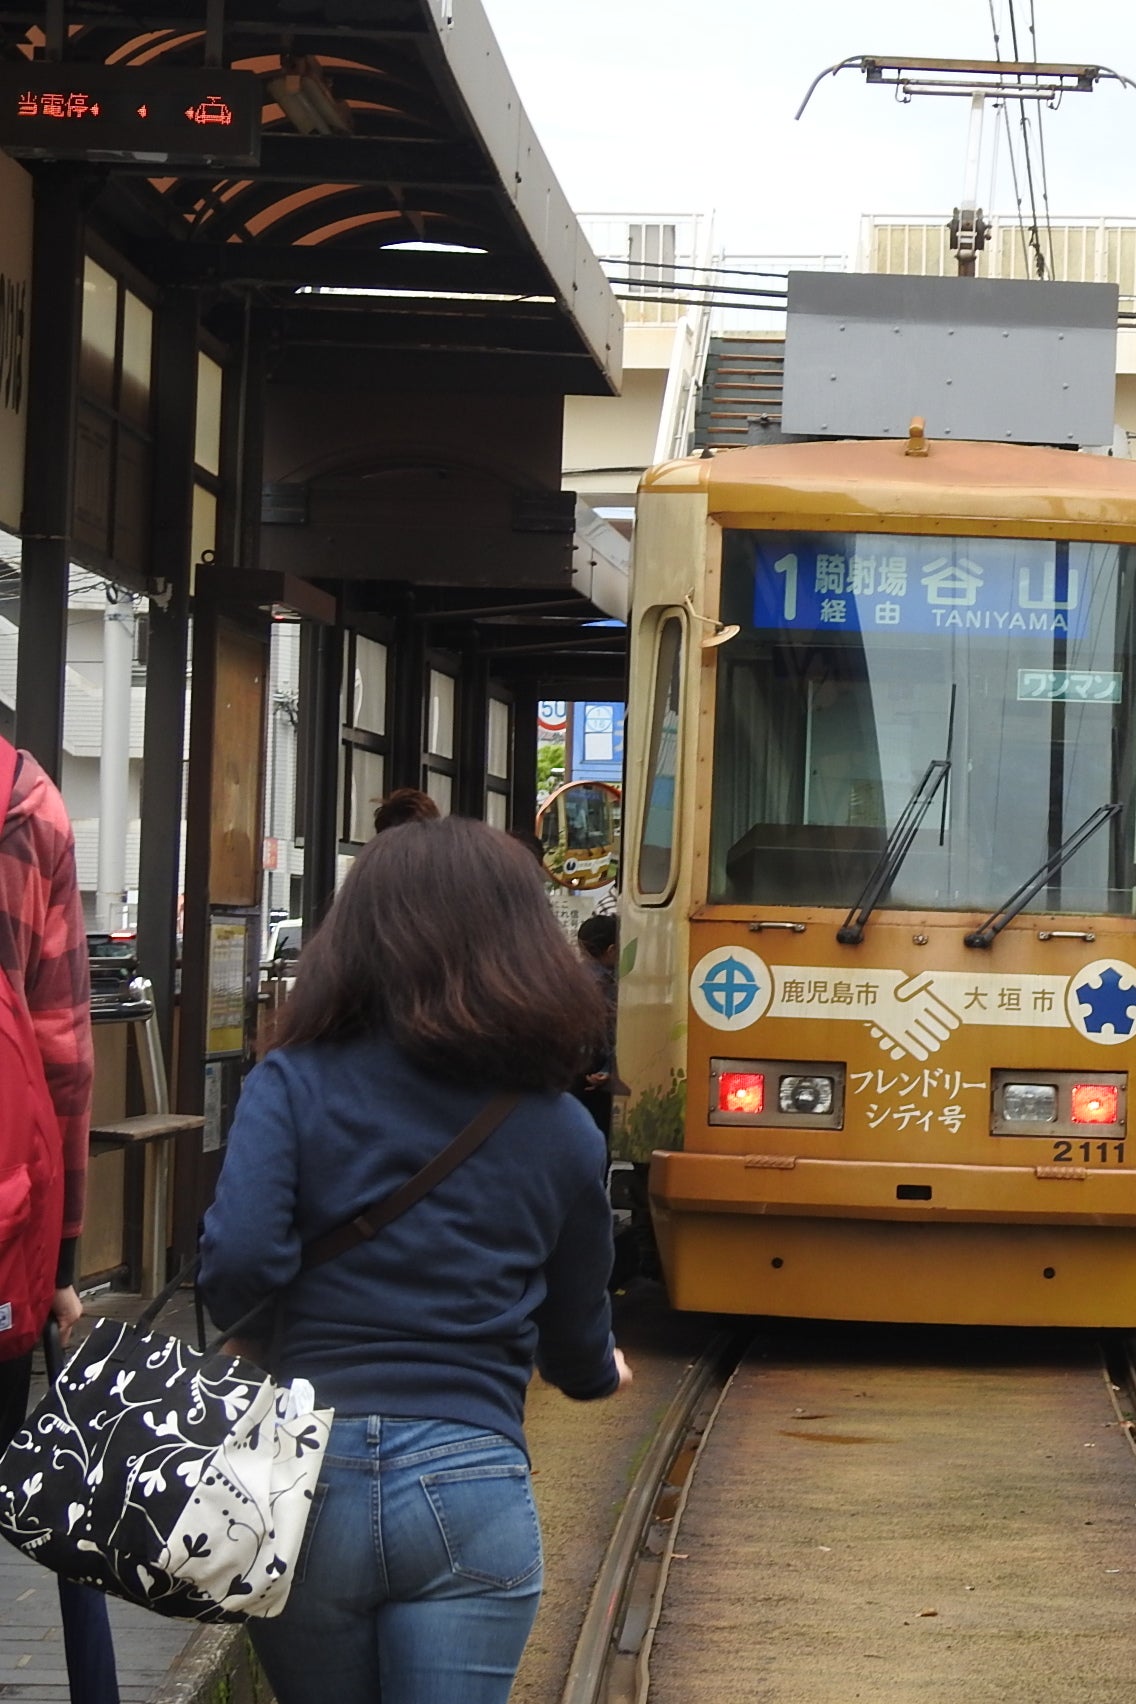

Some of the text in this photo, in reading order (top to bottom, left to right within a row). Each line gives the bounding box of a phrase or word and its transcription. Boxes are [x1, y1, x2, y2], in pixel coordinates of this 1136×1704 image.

[18, 91, 89, 118] 当電停
[774, 552, 798, 621] 1
[814, 552, 908, 597] 騎射場
[920, 555, 1079, 611] 谷山
[820, 598, 901, 626] 経由
[931, 608, 1069, 632] TANIYAMA
[1023, 672, 1117, 699] ワンマン
[780, 978, 880, 1008] 鹿児島市
[963, 986, 1056, 1013] 大垣市
[850, 1067, 988, 1100] フレンドリー
[864, 1102, 967, 1134] シティ号
[1052, 1140, 1126, 1164] 2111
